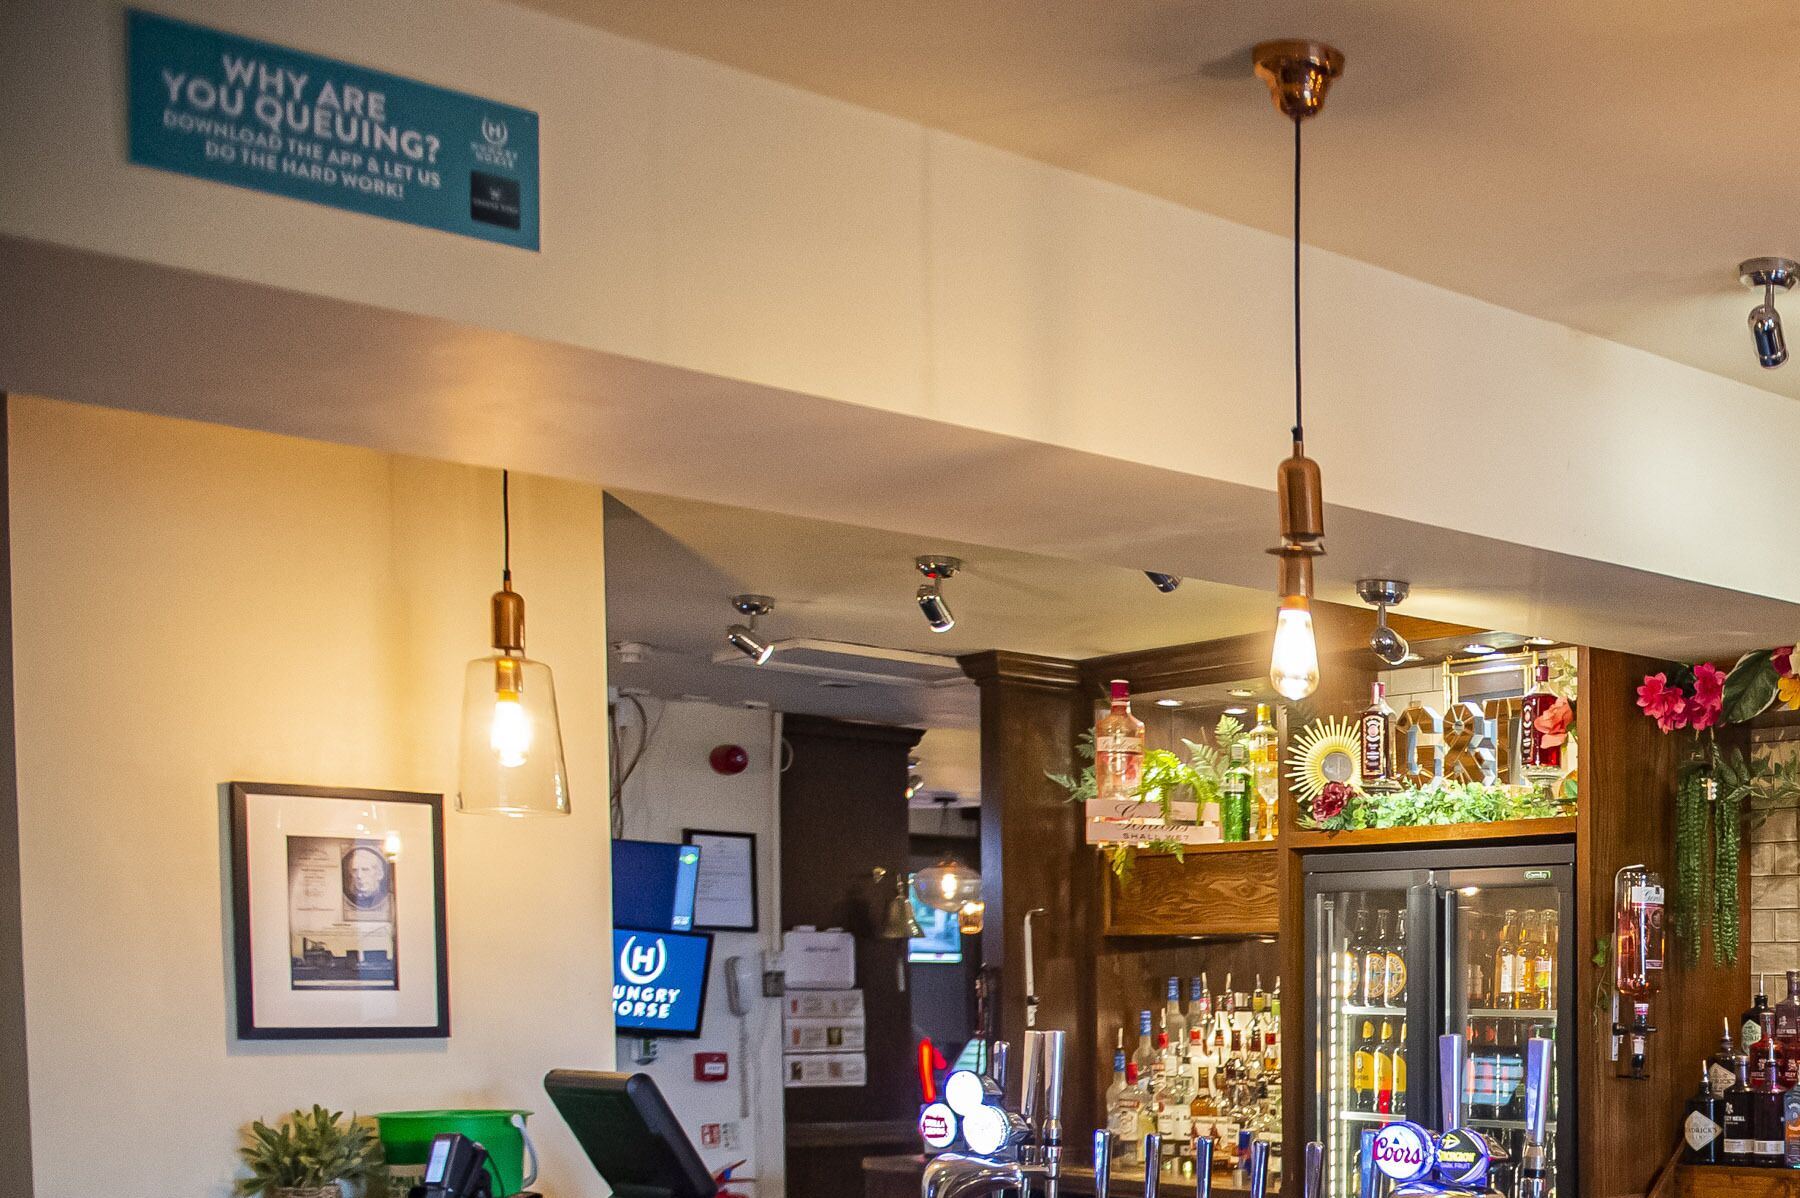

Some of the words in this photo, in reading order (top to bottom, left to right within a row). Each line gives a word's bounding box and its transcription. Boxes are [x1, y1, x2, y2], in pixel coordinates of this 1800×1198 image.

[162, 69, 244, 116] YOU
[254, 96, 441, 164] QUEUING?
[223, 54, 308, 100] WHY
[315, 80, 385, 122] ARE
[163, 109, 282, 151] DOWNLOAD
[288, 138, 323, 160] THE
[328, 149, 363, 168] APP
[367, 157, 379, 174] &
[384, 160, 413, 179] LET
[417, 168, 441, 189] US
[205, 140, 235, 162] DO
[242, 148, 277, 171] THE
[282, 156, 337, 184] HARD
[341, 171, 405, 199] WORK!
[612, 984, 681, 1004] UNGRY
[1373, 1137, 1422, 1164] Coors
